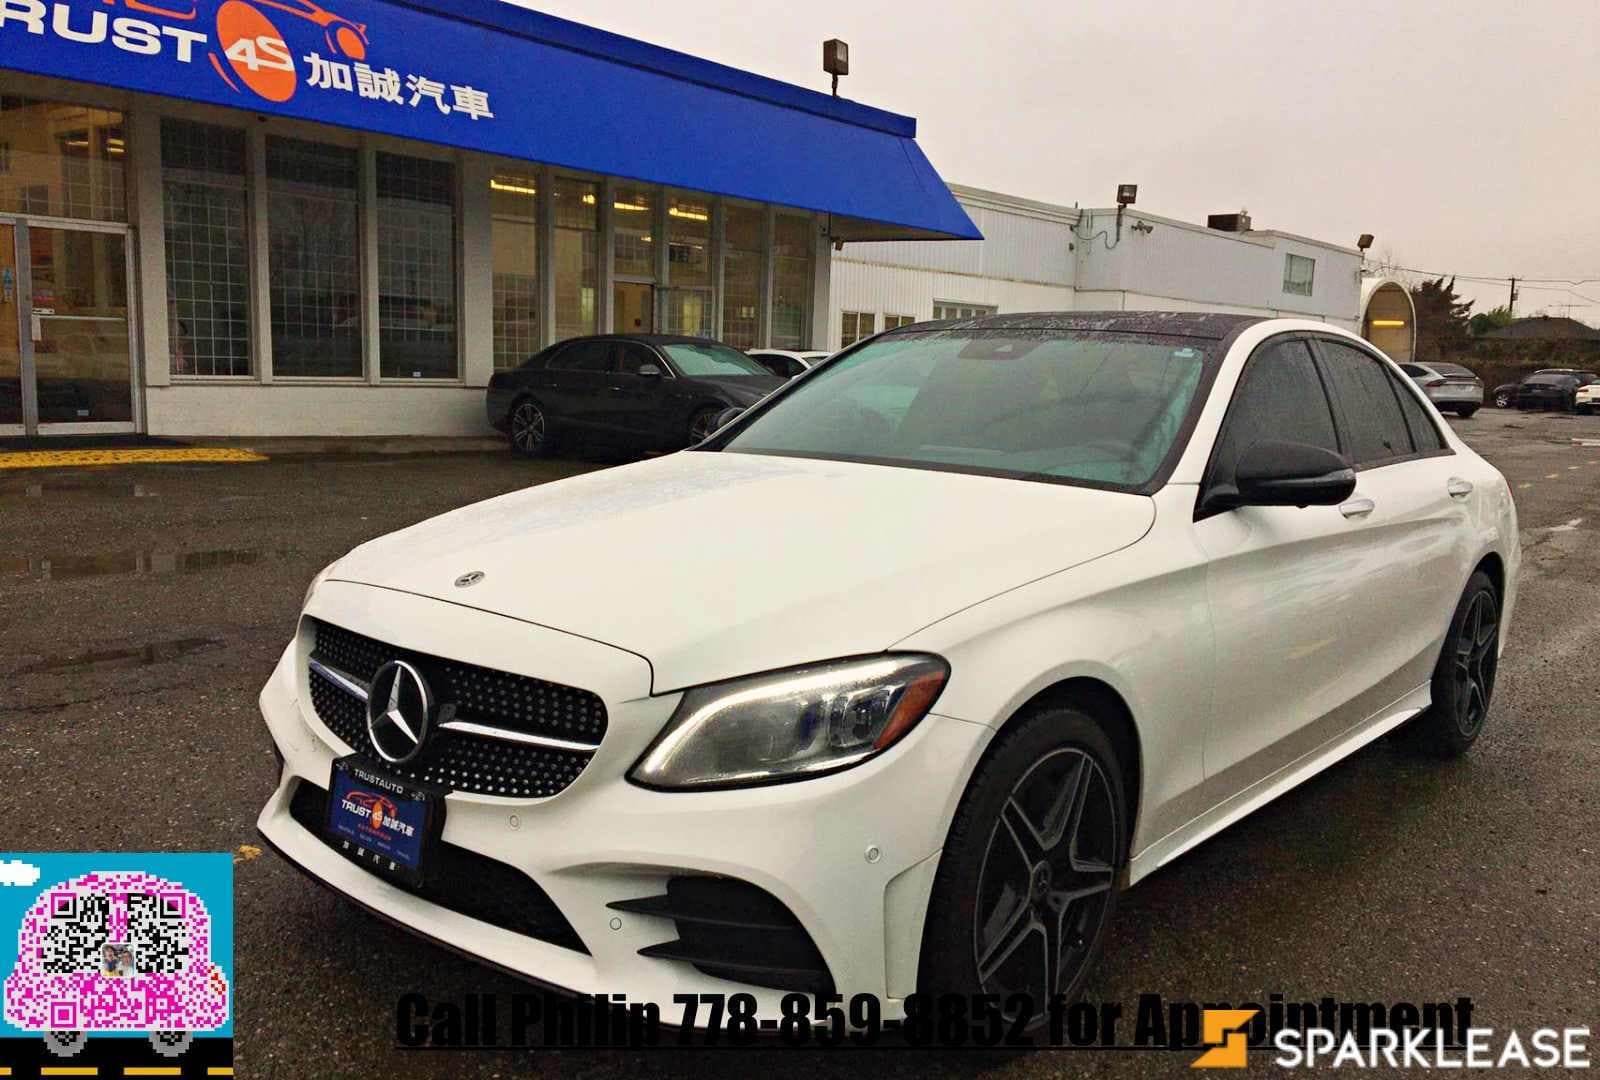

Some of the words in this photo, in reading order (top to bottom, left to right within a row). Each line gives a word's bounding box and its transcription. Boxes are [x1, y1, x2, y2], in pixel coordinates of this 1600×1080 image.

[225, 36, 294, 72] 4S
[303, 52, 494, 121] 加誠汽車
[353, 768, 404, 794] TRUSTAUTO
[341, 799, 372, 819] TRUST
